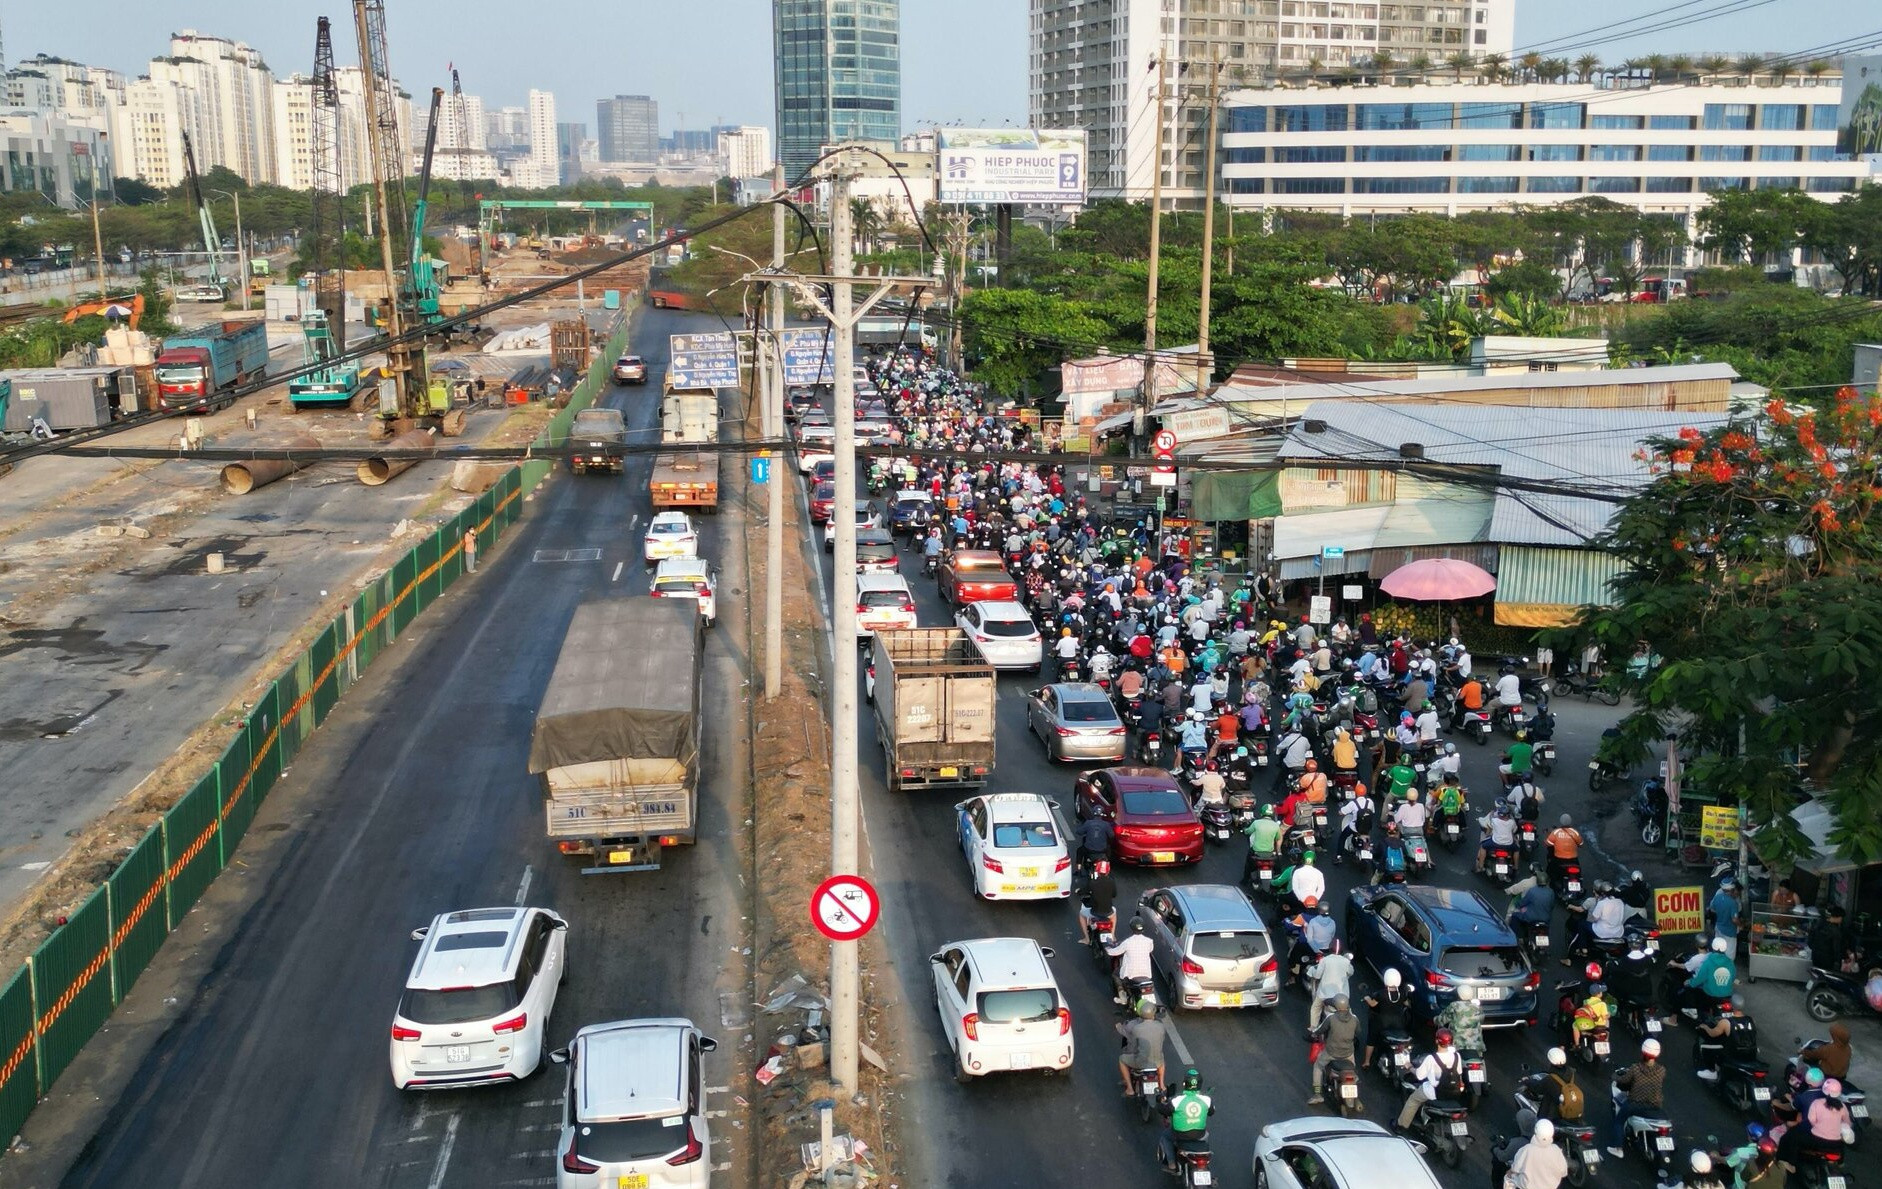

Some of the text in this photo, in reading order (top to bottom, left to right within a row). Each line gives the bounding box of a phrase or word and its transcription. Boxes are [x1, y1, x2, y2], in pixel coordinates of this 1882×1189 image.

[985, 157, 1055, 167] HIEP PHUOC
[985, 167, 1055, 175] INDUSTRIAL PARK
[1063, 165, 1075, 180] 9
[1657, 891, 1700, 913] CƠM
